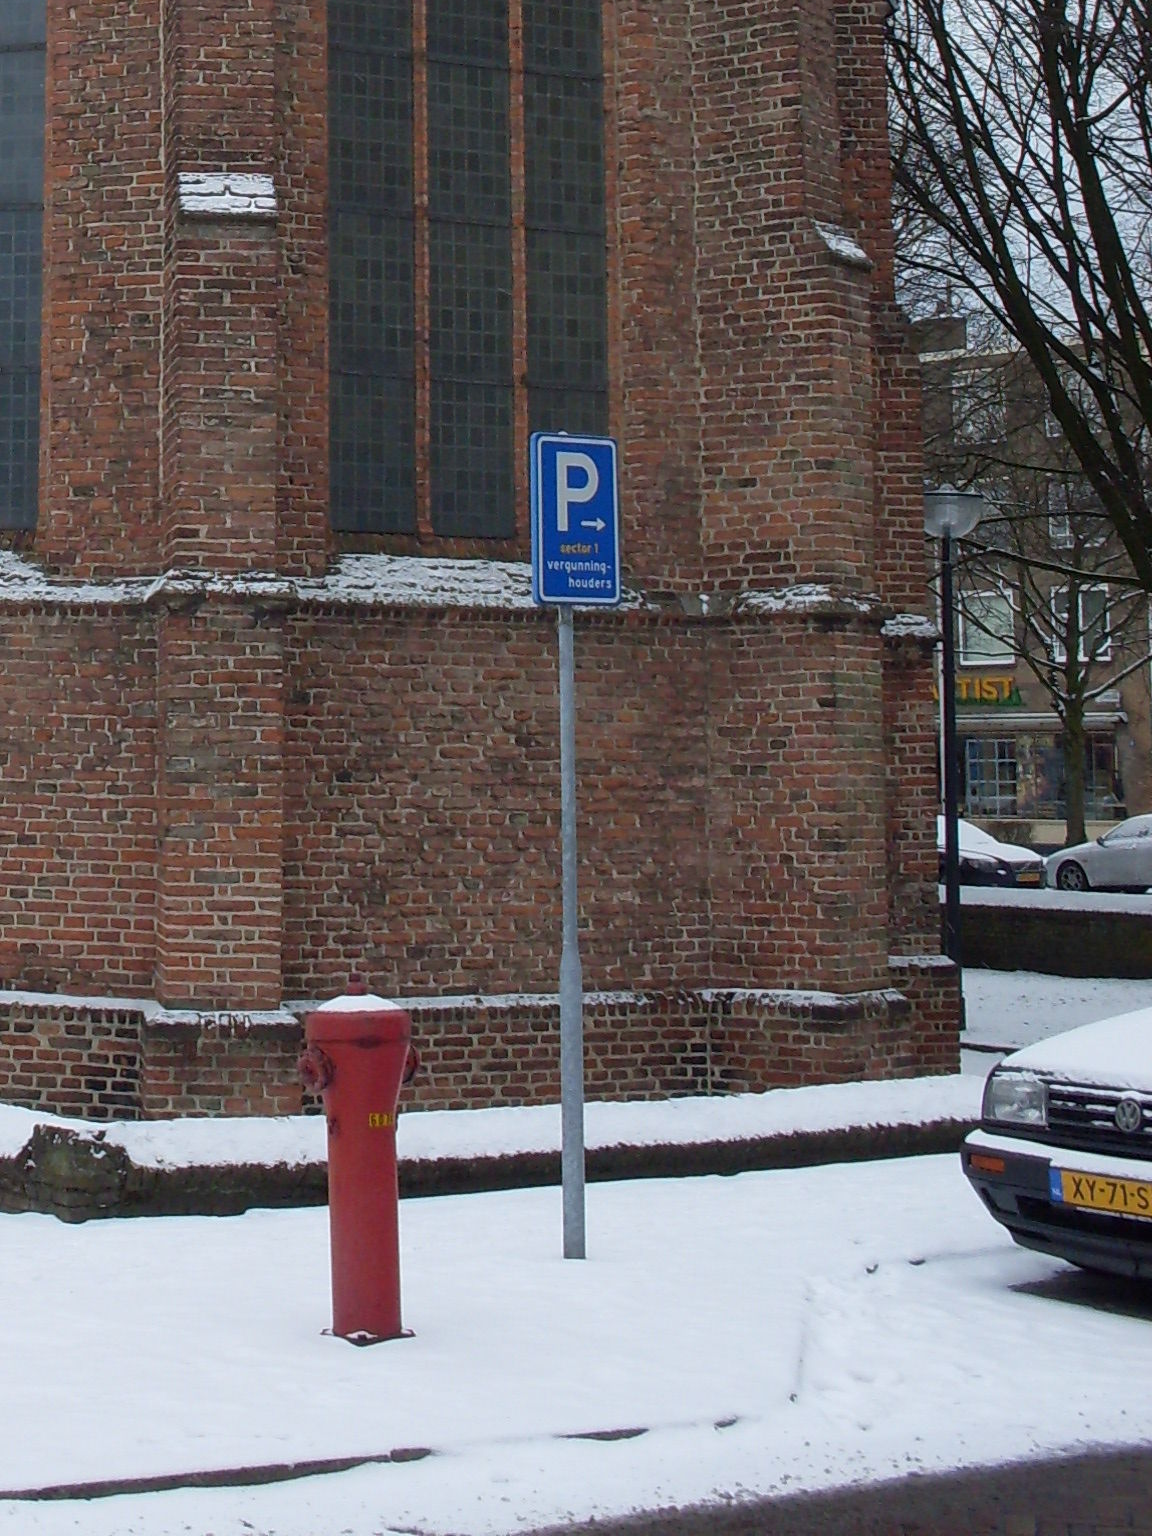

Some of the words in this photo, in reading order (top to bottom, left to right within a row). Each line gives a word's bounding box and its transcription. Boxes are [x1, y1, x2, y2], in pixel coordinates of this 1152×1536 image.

[556, 451, 599, 532] P
[560, 543, 592, 554] sector
[594, 543, 599, 554] 1
[547, 560, 611, 575] vergunning-
[568, 576, 612, 589] houders
